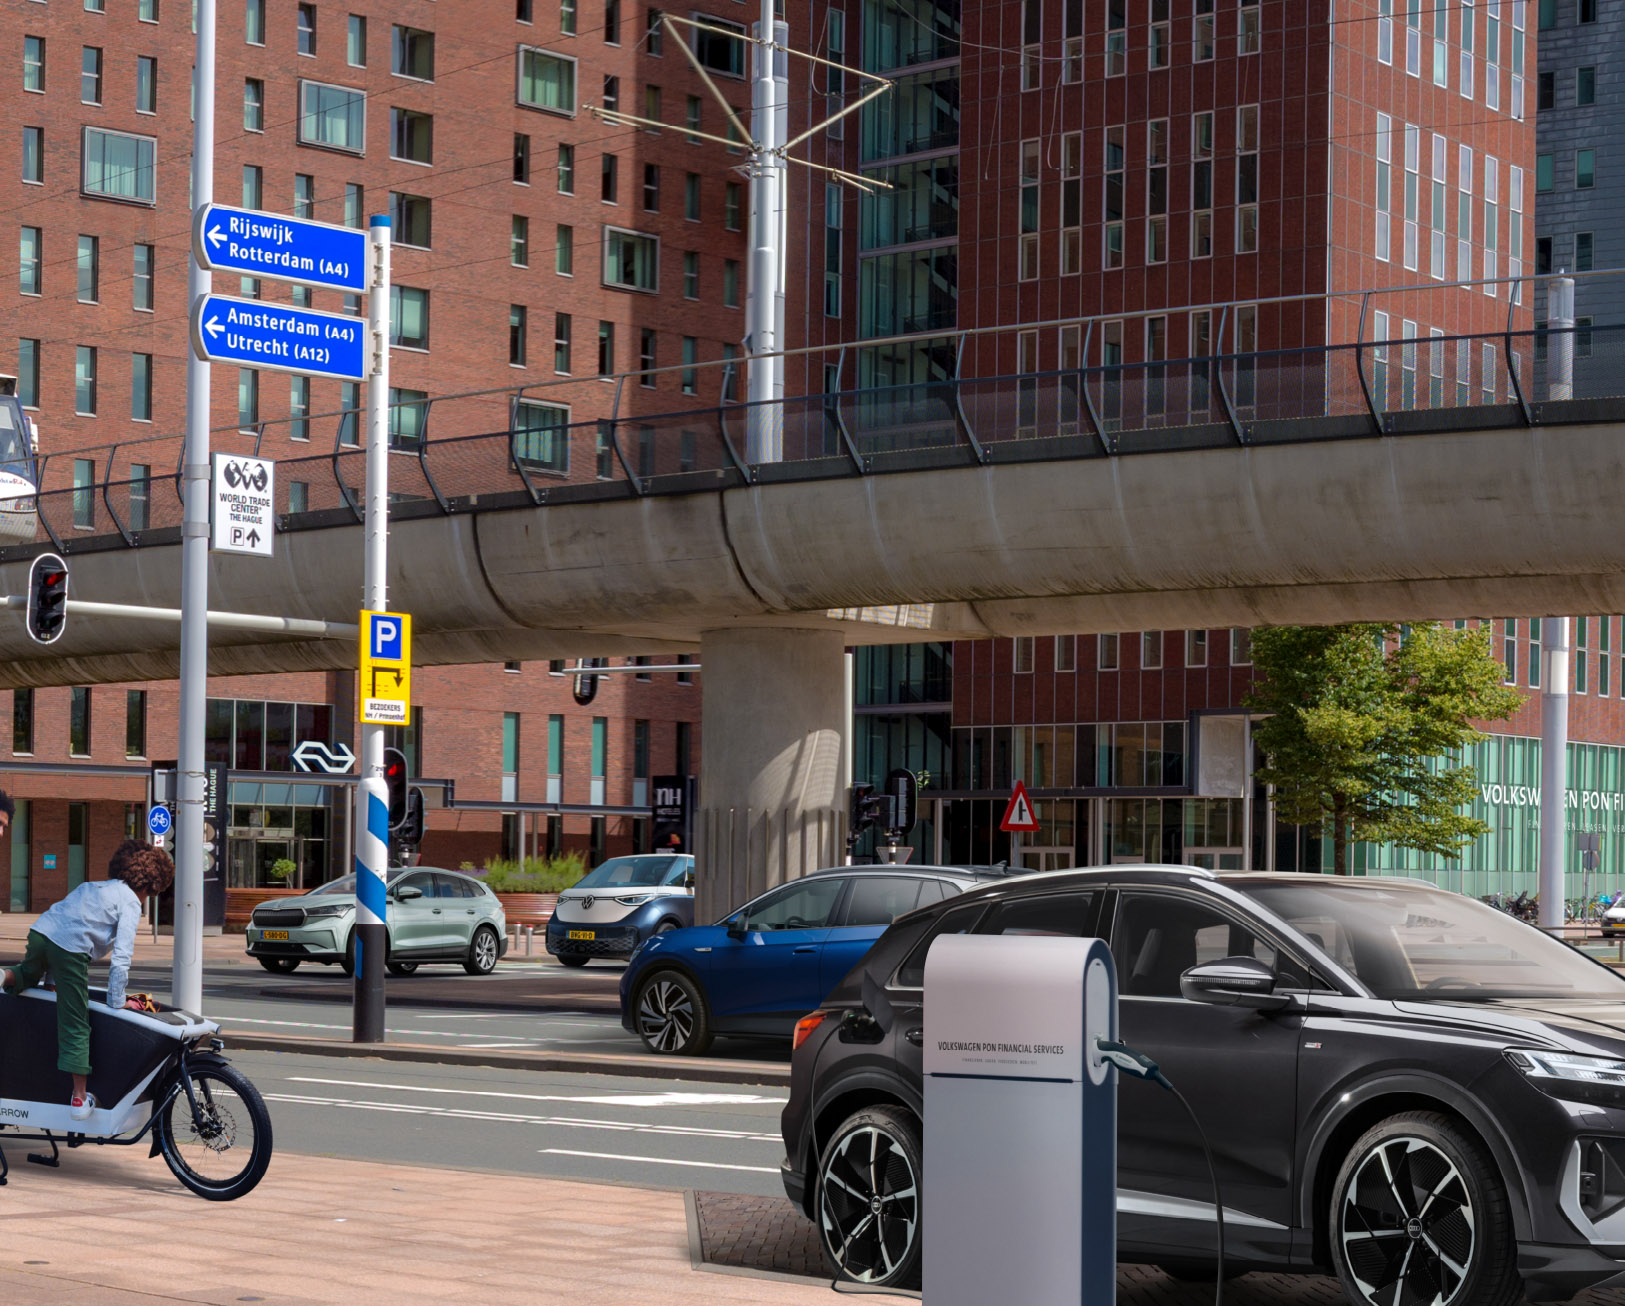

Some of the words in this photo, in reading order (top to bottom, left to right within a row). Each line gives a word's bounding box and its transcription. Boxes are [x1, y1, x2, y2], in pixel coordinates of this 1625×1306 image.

[229, 216, 293, 246] Rijswijk
[229, 242, 314, 271] Rotterdam
[319, 258, 349, 279] (A4)
[227, 307, 319, 337] Amsterdam
[325, 324, 355, 343] (A4)
[227, 333, 289, 357] Utrecht
[294, 343, 330, 364] (A12)
[219, 493, 247, 504] WORLD
[249, 496, 270, 507] TRADE
[229, 513, 241, 522] THE
[242, 515, 263, 525] HAGUE
[233, 529, 242, 543] P
[376, 620, 396, 653] P
[369, 703, 401, 712] BEZOEKERS
[209, 768, 217, 796] HAGUE
[209, 796, 217, 813] THE
[1582, 790, 1609, 811] PON
[938, 1041, 981, 1052] VOLKSWAGEN
[982, 1043, 997, 1052] PON
[997, 1043, 1032, 1054] FINANCIAL
[1033, 1045, 1064, 1055] SERVICES
